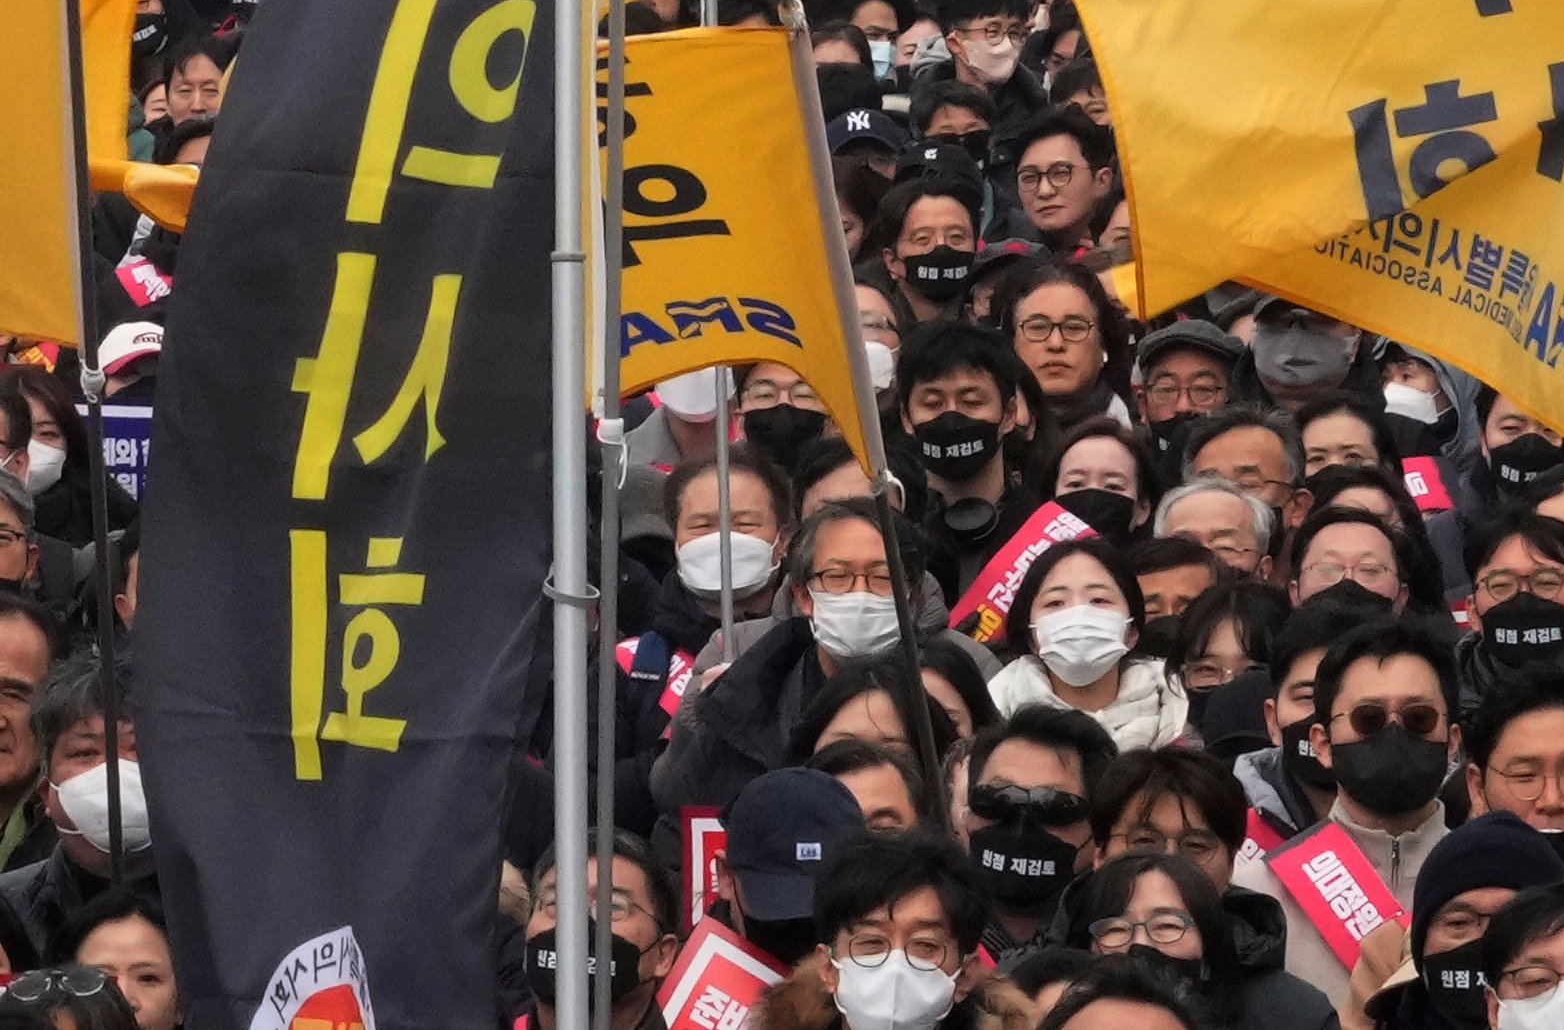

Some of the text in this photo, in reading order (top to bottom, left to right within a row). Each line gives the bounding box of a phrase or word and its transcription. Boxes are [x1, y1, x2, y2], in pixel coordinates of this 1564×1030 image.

[1495, 626, 1562, 645] 원점 재검토
[981, 848, 1056, 877] 원점 재검토
[1440, 970, 1471, 989] 원점
